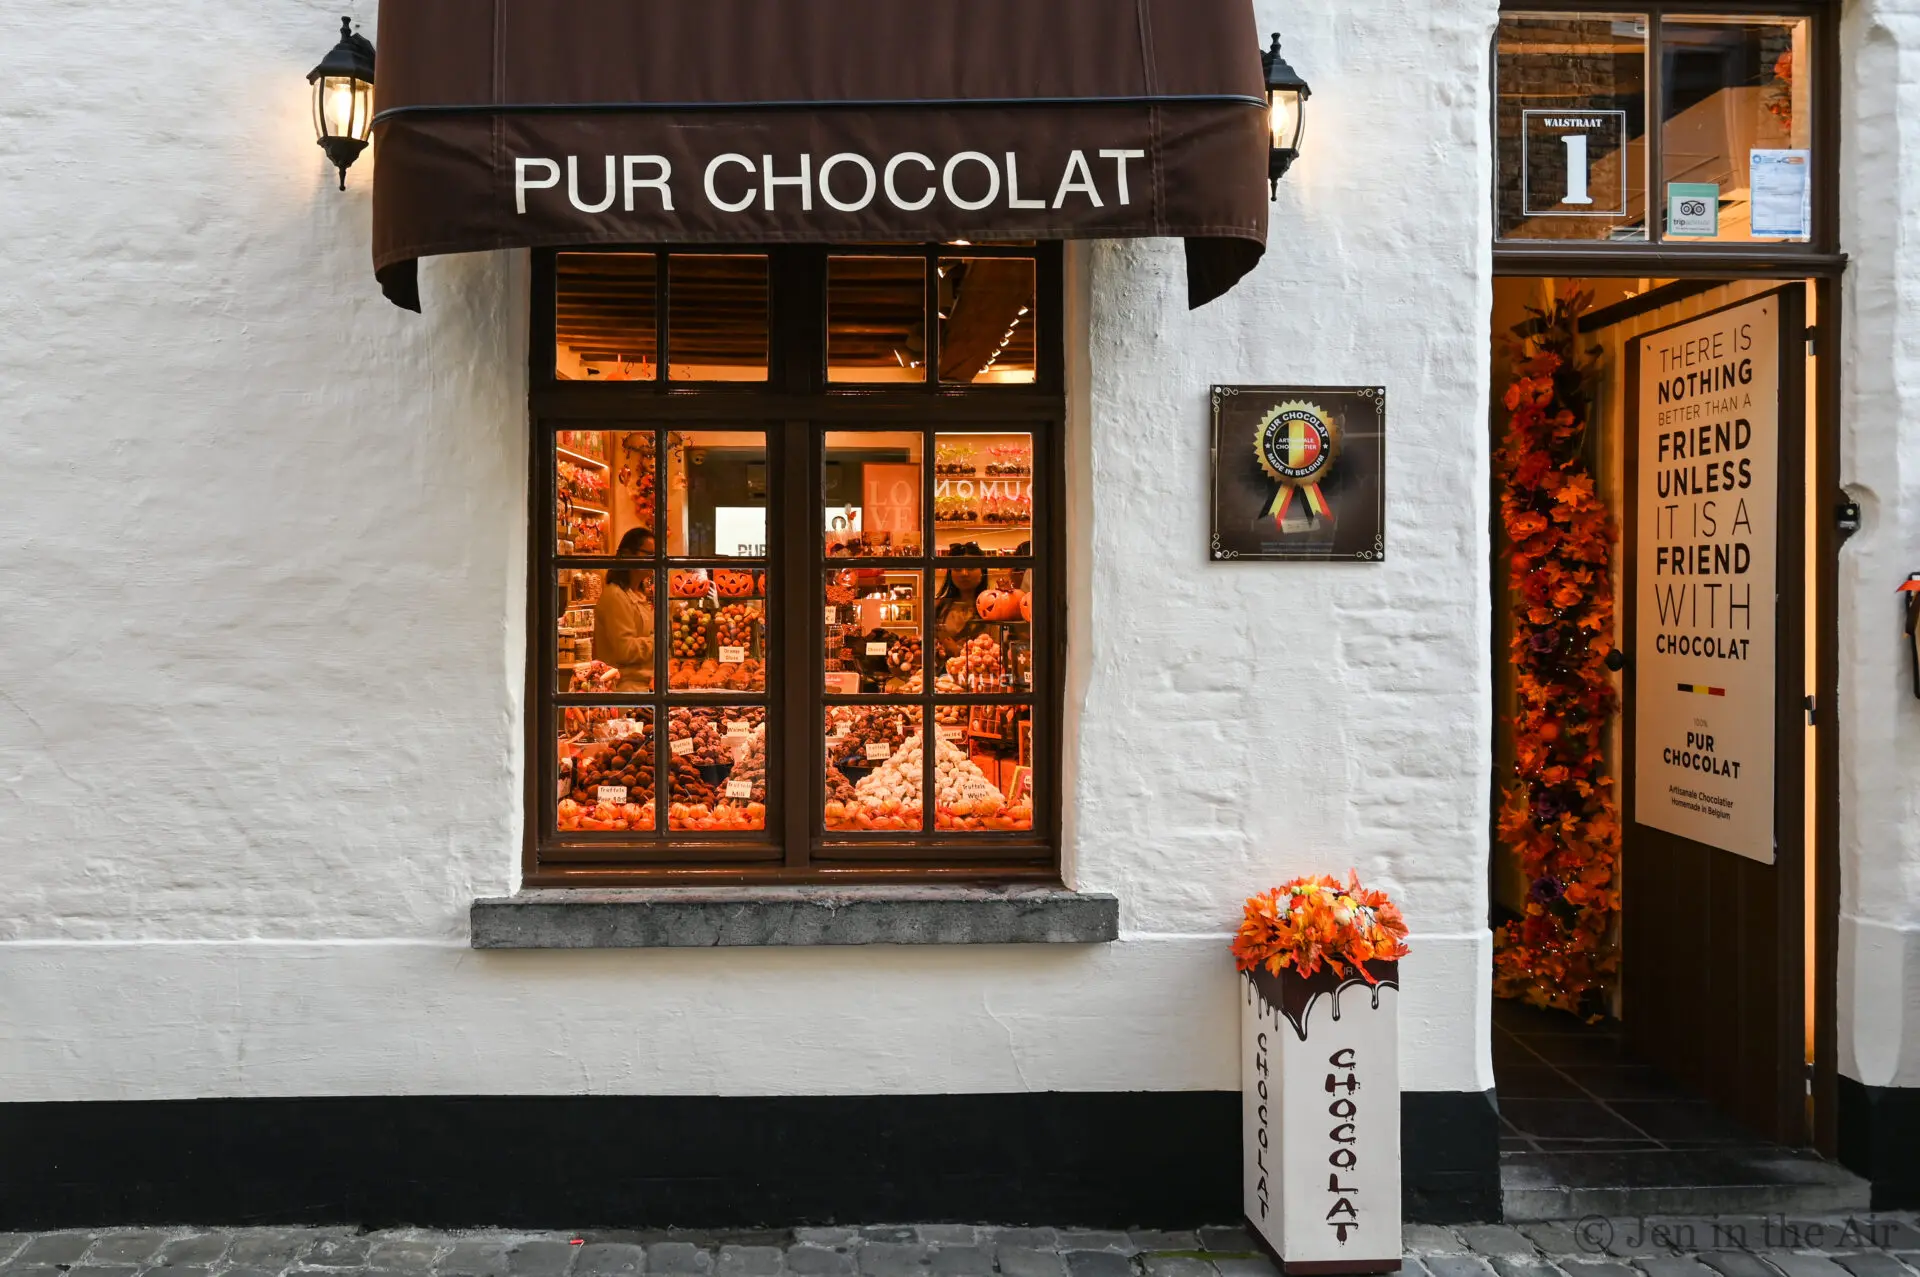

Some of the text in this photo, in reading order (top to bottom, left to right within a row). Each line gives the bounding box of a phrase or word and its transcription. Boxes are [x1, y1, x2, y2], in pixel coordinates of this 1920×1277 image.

[1543, 118, 1603, 128] WALSTRAAT
[514, 149, 1145, 214] PUR CHOCOLAT
[1561, 135, 1593, 205] 1
[1660, 323, 1752, 373] THERE IS
[1658, 358, 1753, 405] NOTHING
[1266, 411, 1329, 438] PUR CHOCOLAT
[1658, 393, 1752, 426] BETTER THAN A
[1658, 418, 1751, 463] FRIEND
[1267, 453, 1285, 472] MADE
[1295, 454, 1325, 476] BELGIUM
[1657, 458, 1752, 499] UNLESS
[1656, 498, 1752, 540] IT IS A
[1656, 542, 1750, 576] FRIEND
[1655, 583, 1750, 630] WITH
[1656, 634, 1750, 661] CHOCOLAT
[1687, 731, 1714, 752] PUR
[1663, 747, 1741, 779] CHOCOLAT
[1669, 784, 1734, 809] Artisanale Chocolatier
[1671, 797, 1731, 820] Homemade in Belgium
[1256, 1032, 1269, 1222] CHOCOLAT
[1325, 1048, 1361, 1247] CHOCOLAT
